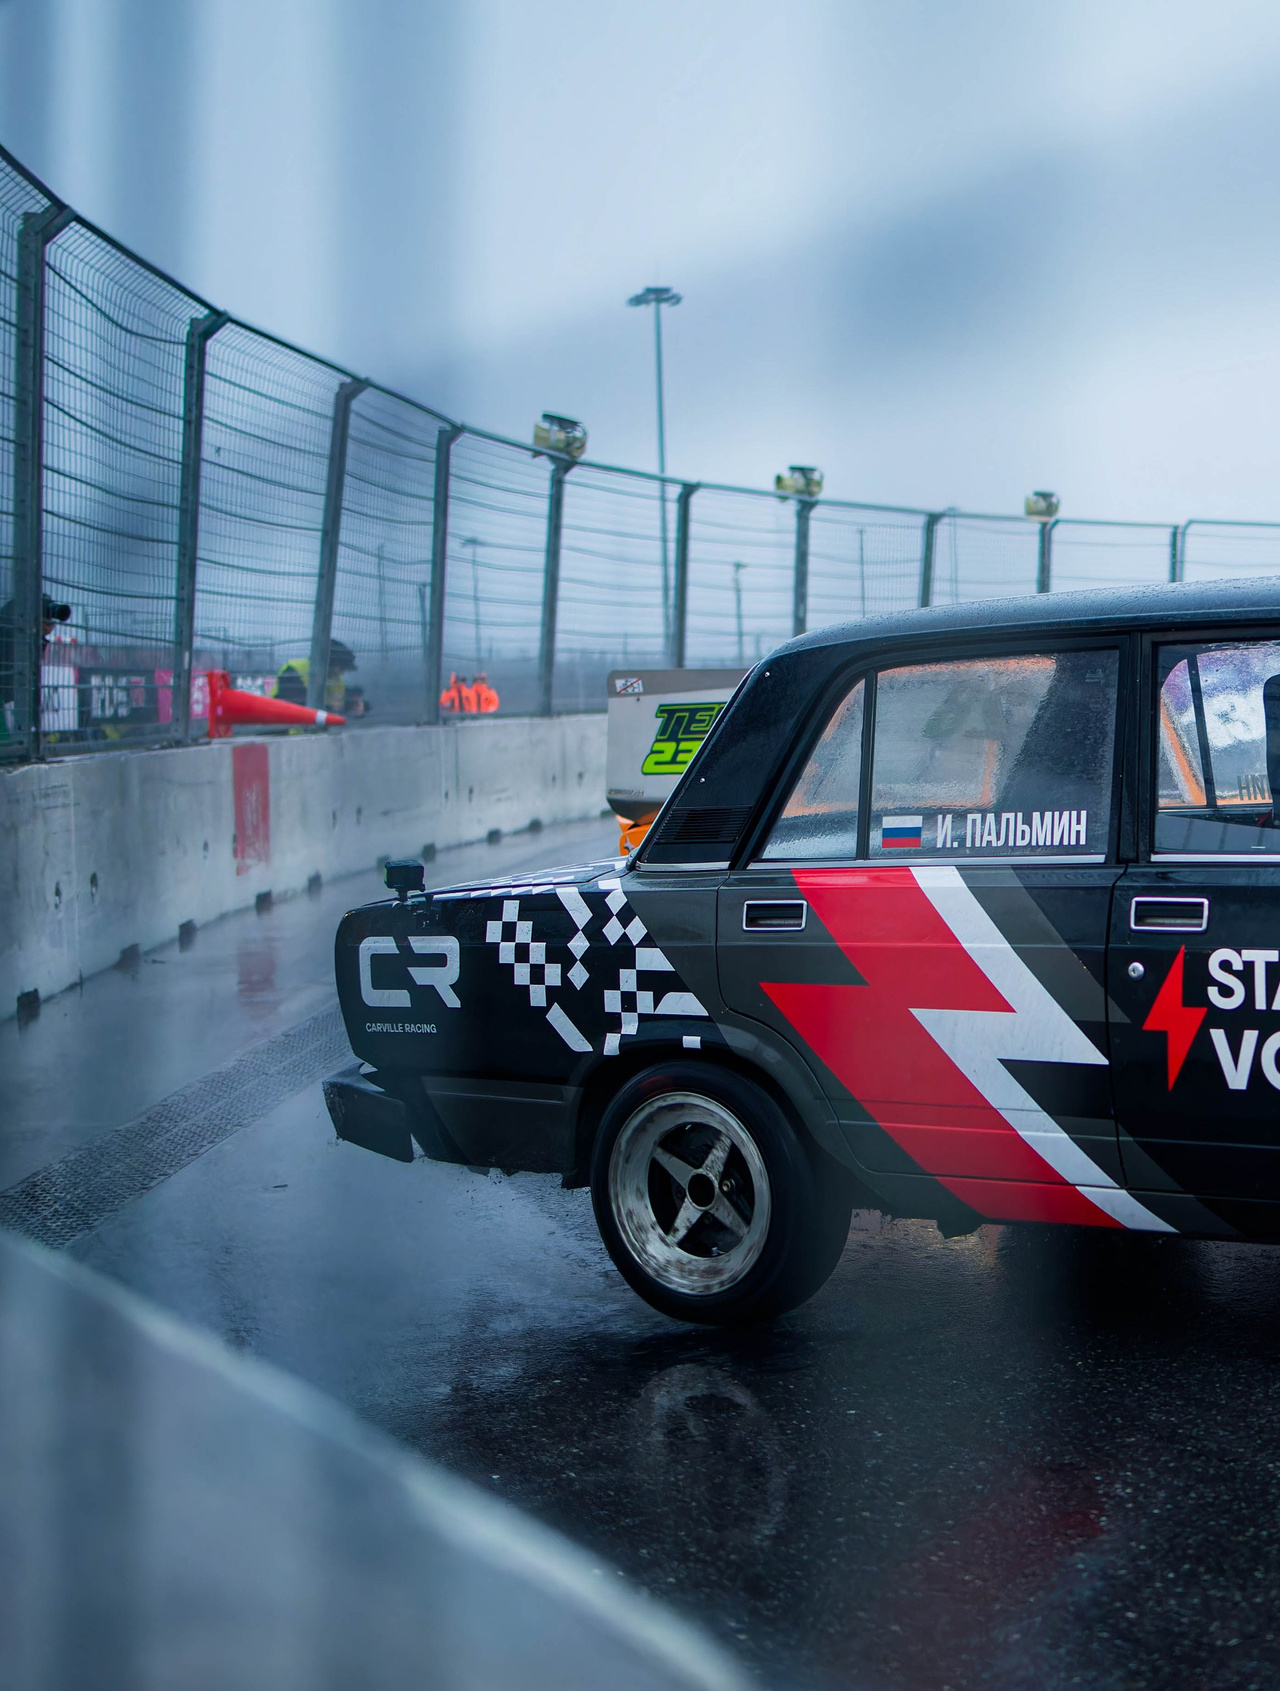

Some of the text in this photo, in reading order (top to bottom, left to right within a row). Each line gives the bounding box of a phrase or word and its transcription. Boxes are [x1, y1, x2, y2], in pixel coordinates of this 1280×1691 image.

[655, 702, 728, 740] TE
[936, 810, 1087, 848] И. ПАЛЬМИН
[359, 935, 461, 1008] CR
[365, 1022, 437, 1034] CARVILLE RACING
